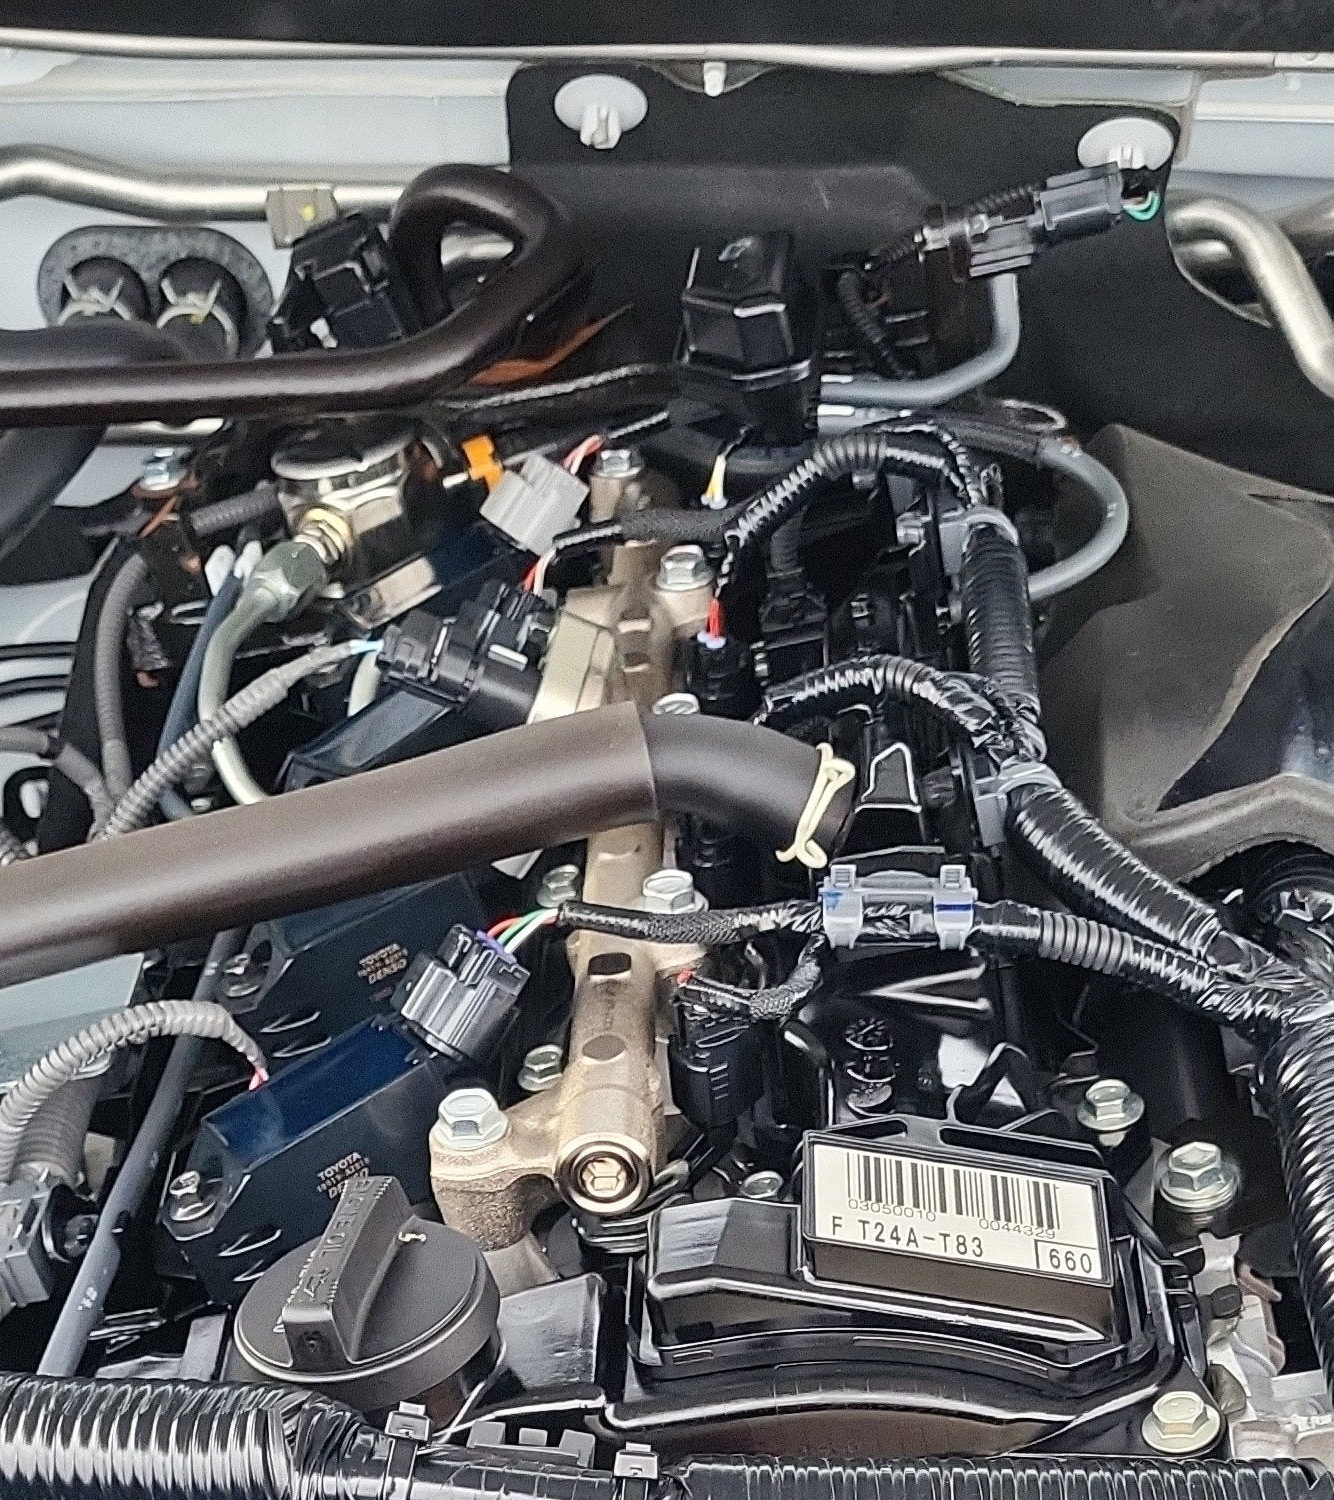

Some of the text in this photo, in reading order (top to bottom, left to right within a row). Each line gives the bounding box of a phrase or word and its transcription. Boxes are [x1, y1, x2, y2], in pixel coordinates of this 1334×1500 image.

[317, 1152, 362, 1180] TOYOTA
[848, 1198, 1056, 1239] 03050010 0044329
[832, 1215, 1093, 1274] F T24A-T83 660
